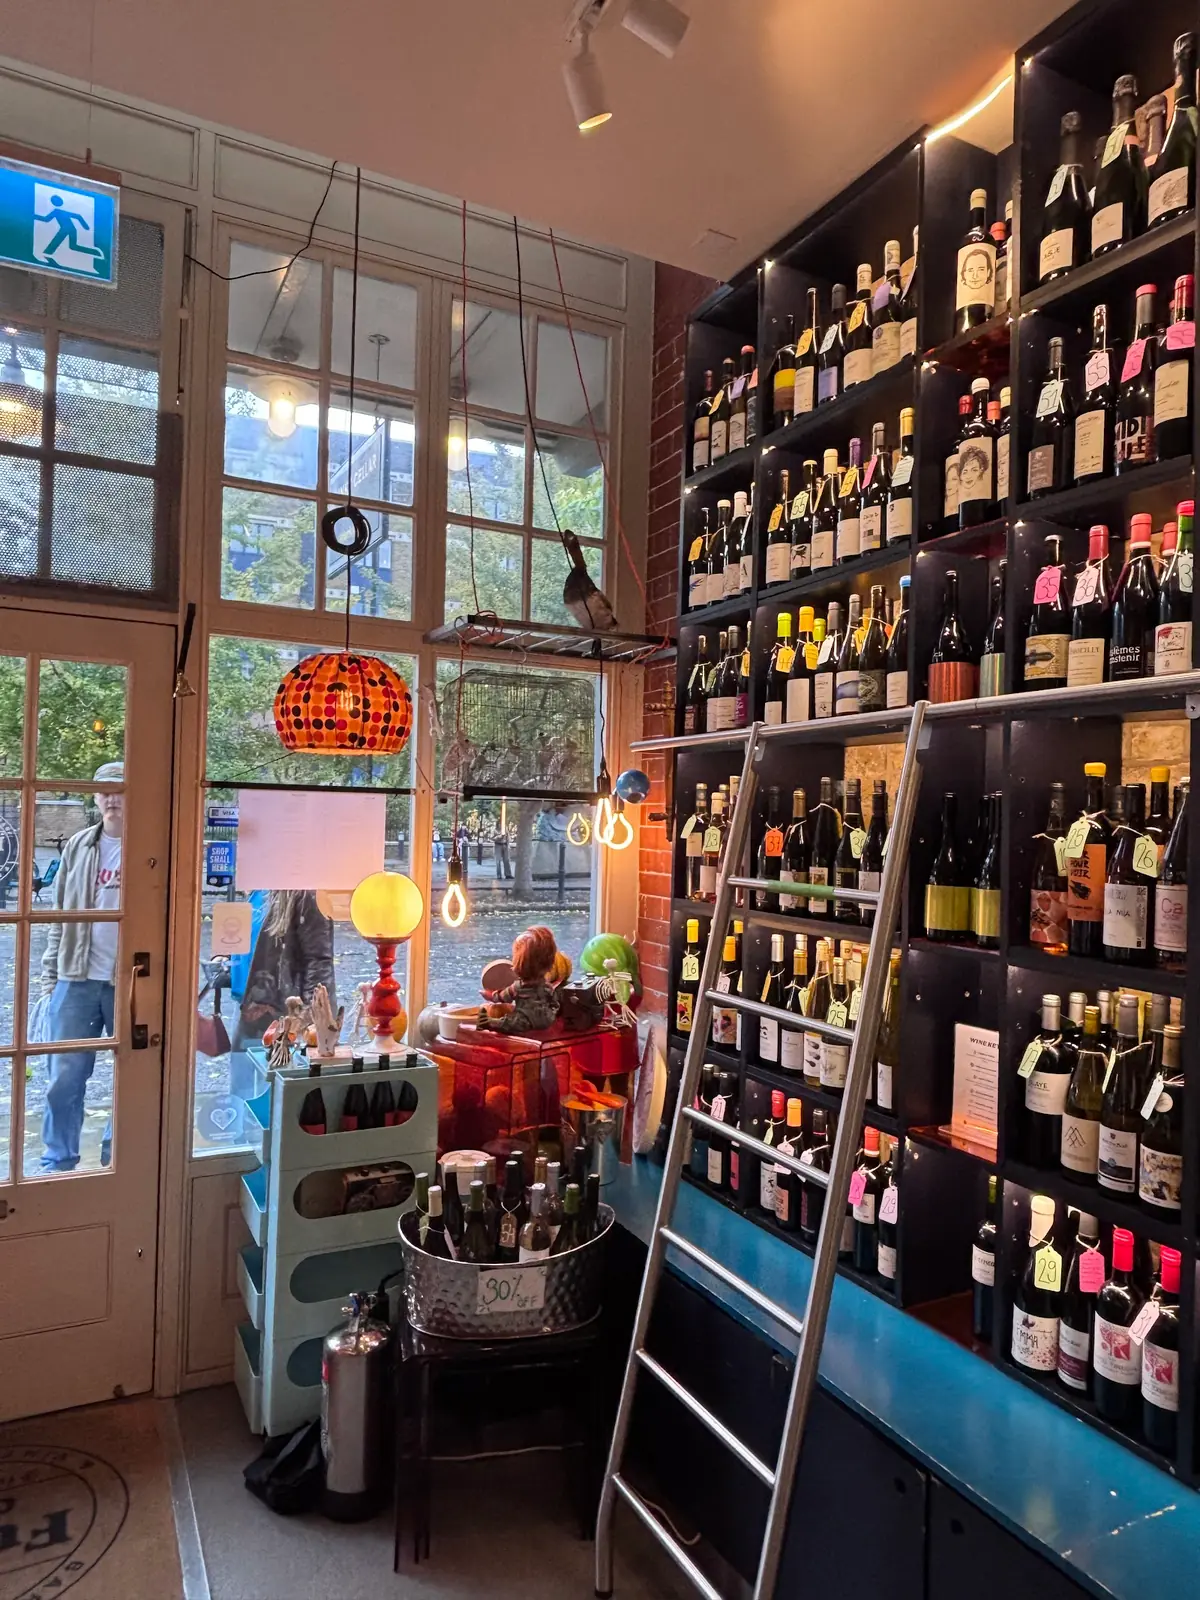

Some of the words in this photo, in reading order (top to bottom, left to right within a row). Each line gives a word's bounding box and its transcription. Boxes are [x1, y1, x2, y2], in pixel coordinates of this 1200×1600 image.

[1086, 358, 1108, 387] 55
[1039, 389, 1059, 414] 51
[354, 454, 377, 488] CELLAR
[1036, 576, 1058, 601] 35
[1075, 577, 1094, 602] 36
[1067, 827, 1086, 850] 25
[209, 855, 231, 864] SMALL
[211, 847, 230, 856] SHOP
[1136, 843, 1154, 870] 26
[211, 863, 229, 872] HERE
[684, 962, 698, 979] 16
[969, 1036, 988, 1048] WINE
[882, 1195, 897, 1215] 29
[1037, 1257, 1057, 1285] 29
[482, 1274, 523, 1305] 30%
[516, 1295, 538, 1309] OFF
